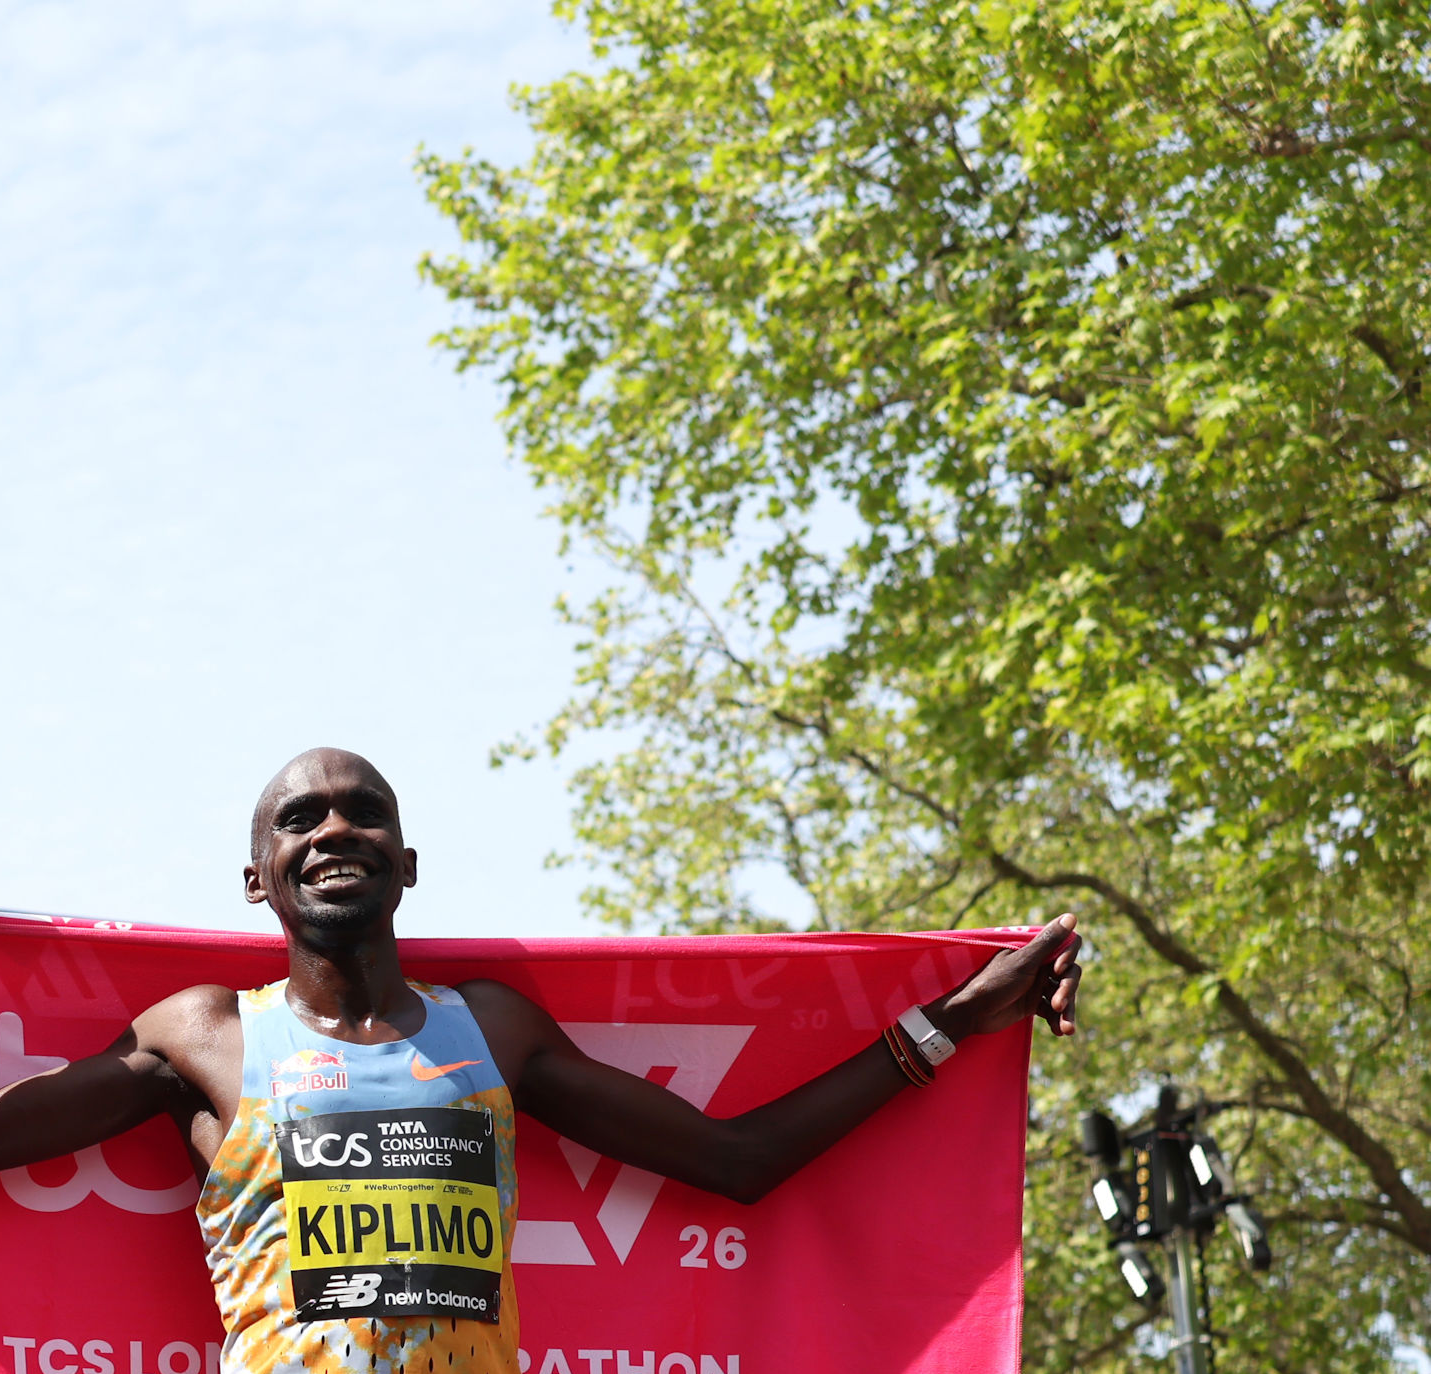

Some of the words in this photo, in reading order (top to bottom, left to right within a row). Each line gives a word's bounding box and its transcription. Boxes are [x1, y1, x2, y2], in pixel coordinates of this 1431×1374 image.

[311, 1072, 349, 1091] Bull
[291, 1131, 372, 1168] tcs
[378, 1121, 427, 1135] TATA
[380, 1139, 483, 1155] CONSULTANCY
[382, 1153, 453, 1168] SERVICES
[364, 1183, 435, 1192] #WeRunTogether
[298, 1203, 494, 1259] KIPLIMO
[678, 1225, 747, 1269] 26
[384, 1291, 421, 1306] new
[426, 1289, 487, 1312] balance
